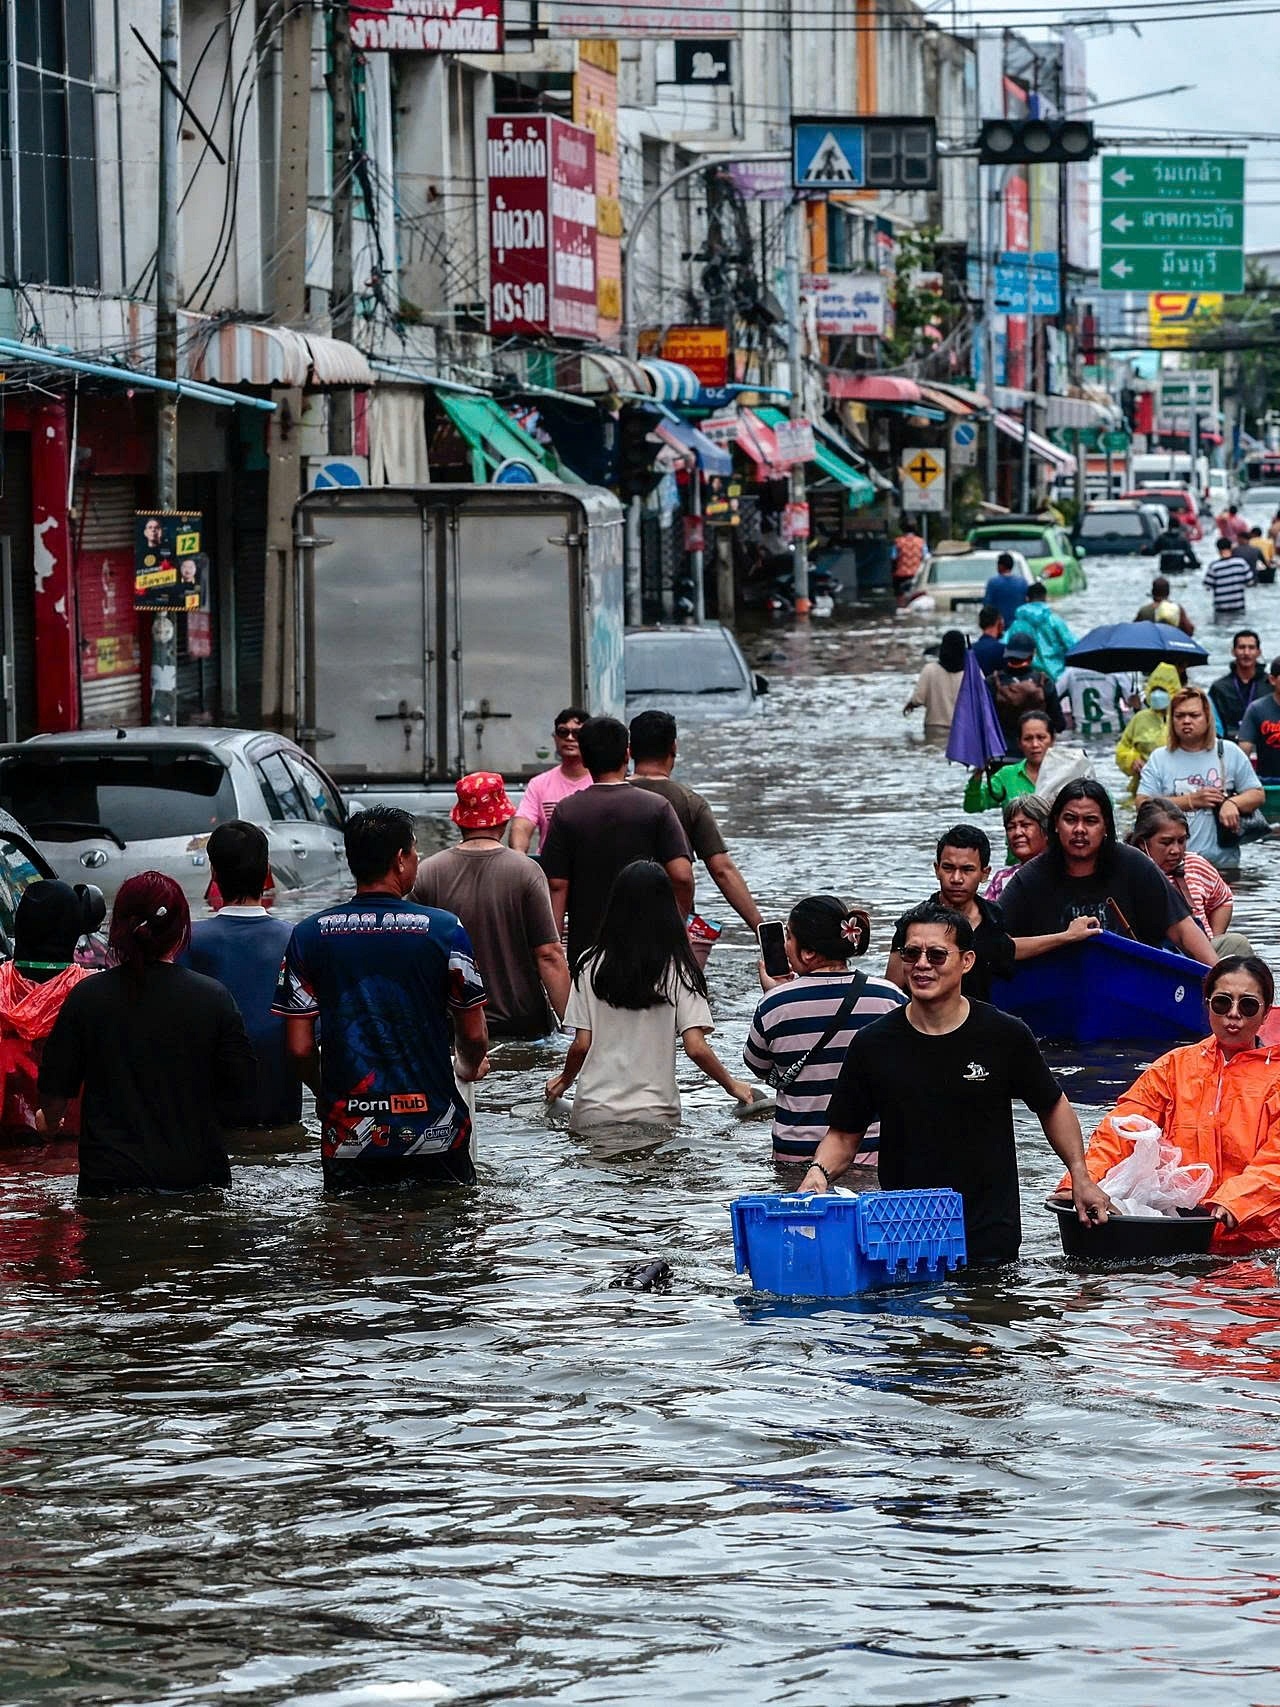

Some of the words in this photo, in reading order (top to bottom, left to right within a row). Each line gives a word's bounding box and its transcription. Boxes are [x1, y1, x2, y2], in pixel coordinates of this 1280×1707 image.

[488, 122, 546, 178] เหล็กดัด
[1152, 160, 1222, 182] ร่มเกล้า
[492, 195, 545, 264] มุ้งลวด
[1143, 205, 1234, 228] ลาดกระบัง
[1162, 250, 1216, 279] มีนบุรี
[493, 282, 545, 322] กระจก
[181, 537, 196, 551] 12
[1082, 687, 1104, 722] 6
[318, 912, 430, 935] THAILAND
[427, 1127, 449, 1139] durex
